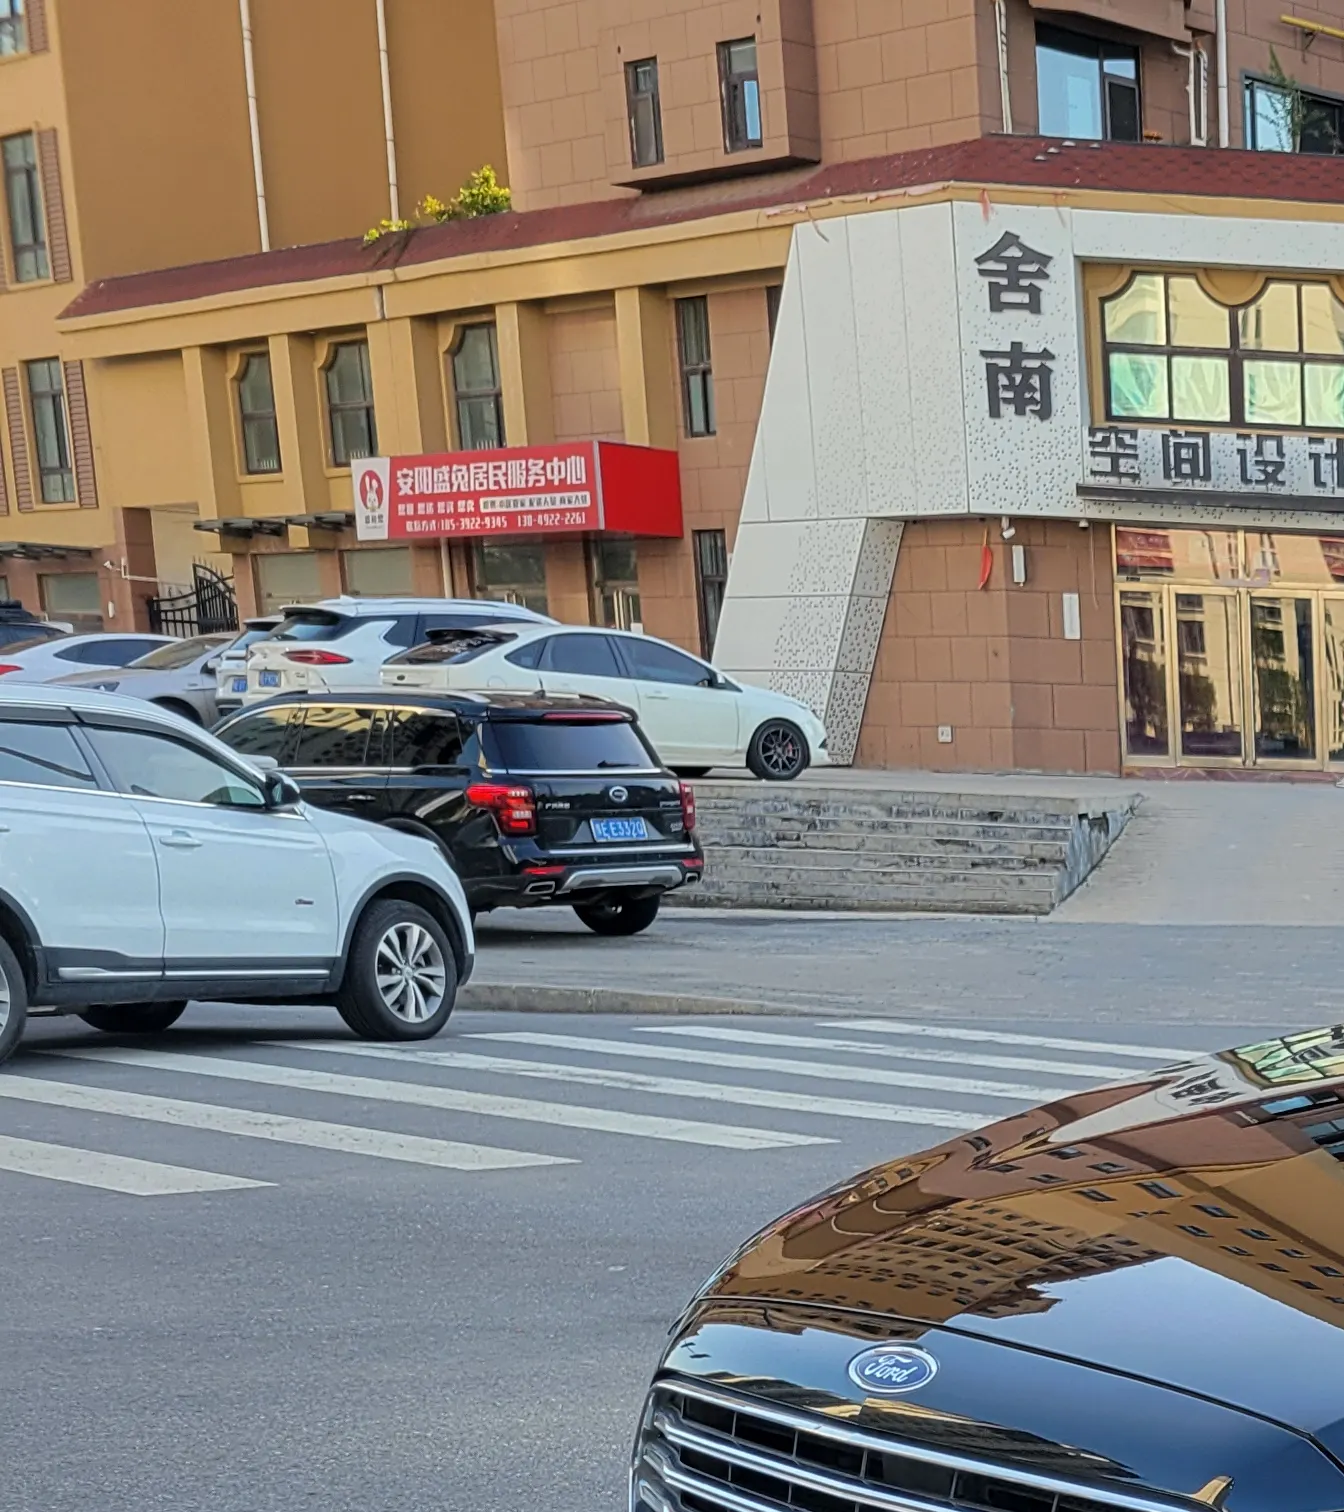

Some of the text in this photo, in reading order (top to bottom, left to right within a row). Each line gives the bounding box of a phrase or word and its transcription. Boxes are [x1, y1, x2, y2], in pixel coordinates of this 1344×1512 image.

[974, 230, 1056, 422] 舍南
[396, 455, 587, 496] 安阳盛兔居民服务中心
[864, 1354, 918, 1383] Ford
